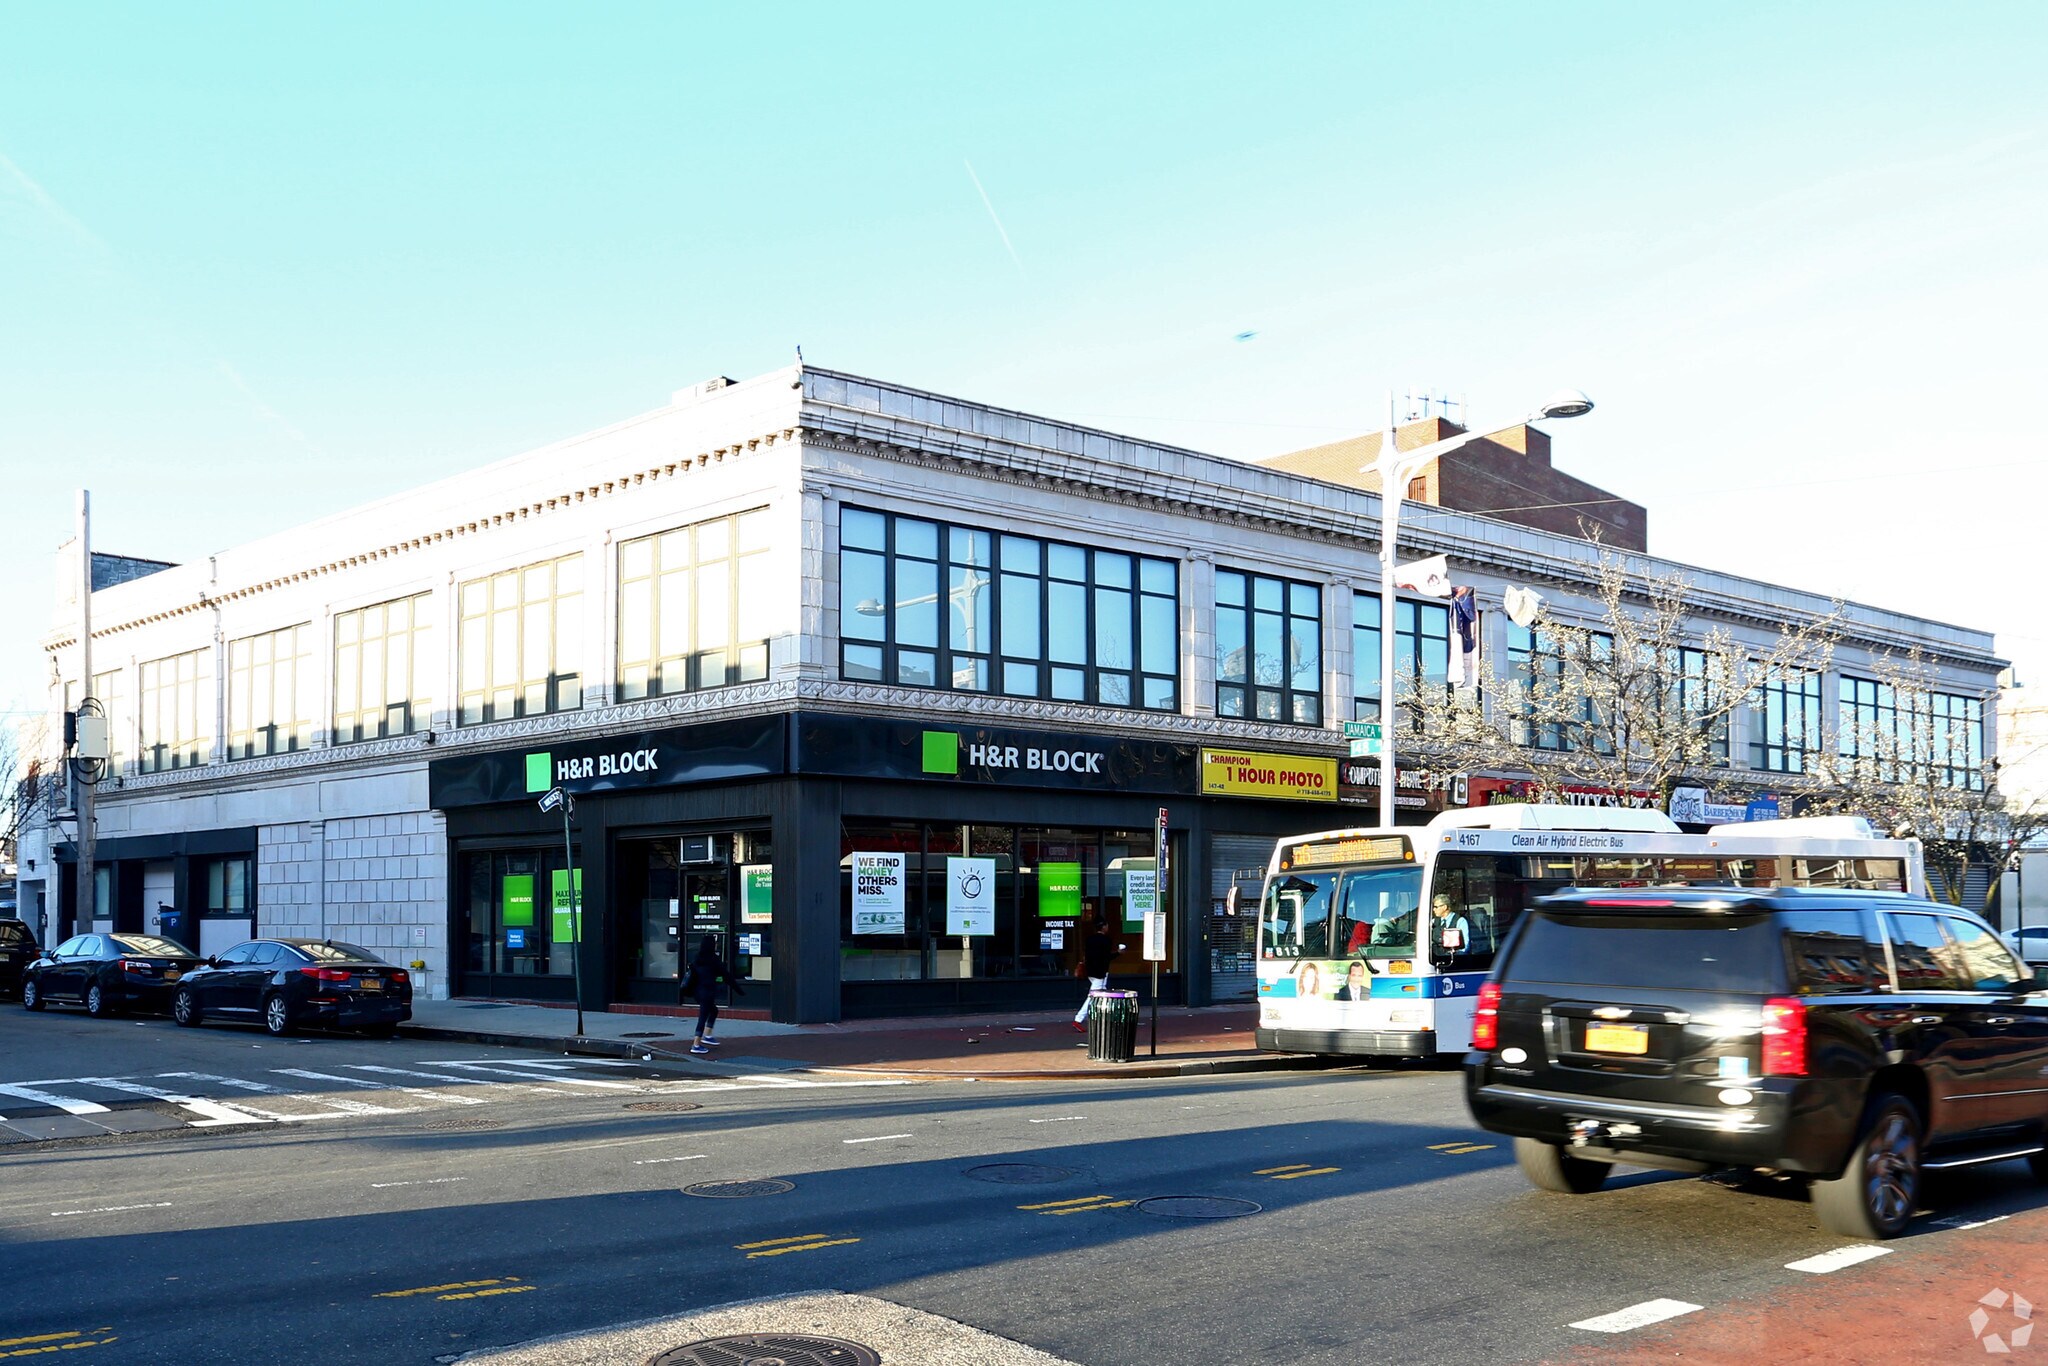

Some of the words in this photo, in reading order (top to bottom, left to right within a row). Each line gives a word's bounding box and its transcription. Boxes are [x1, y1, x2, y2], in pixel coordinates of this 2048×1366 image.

[1346, 723, 1376, 737] JAMAICA
[557, 757, 594, 780] H&R
[599, 748, 658, 776] BLOCK
[969, 744, 1019, 768] H&R
[1026, 748, 1100, 773] BLOCK
[1210, 755, 1251, 766] CHAMPION
[1226, 766, 1232, 781] 1
[1238, 767, 1276, 785] HOUR
[1279, 770, 1324, 788] PHOTO
[1343, 762, 1381, 786] COMPUTE
[1340, 839, 1371, 851] JAMAICA
[1459, 834, 1480, 846] 4167
[1511, 834, 1535, 847] Clean
[1536, 835, 1549, 847] Air
[1550, 835, 1577, 849] Hybrid
[1579, 836, 1608, 848] Electric
[1610, 836, 1624, 848] Bus
[858, 857, 875, 867] WE
[876, 858, 900, 867] FIND
[858, 867, 893, 876] MONEY
[858, 876, 898, 886] OTHERS
[857, 886, 885, 895] MISS.
[171, 918, 177, 926] P
[1454, 981, 1465, 989] Bus
